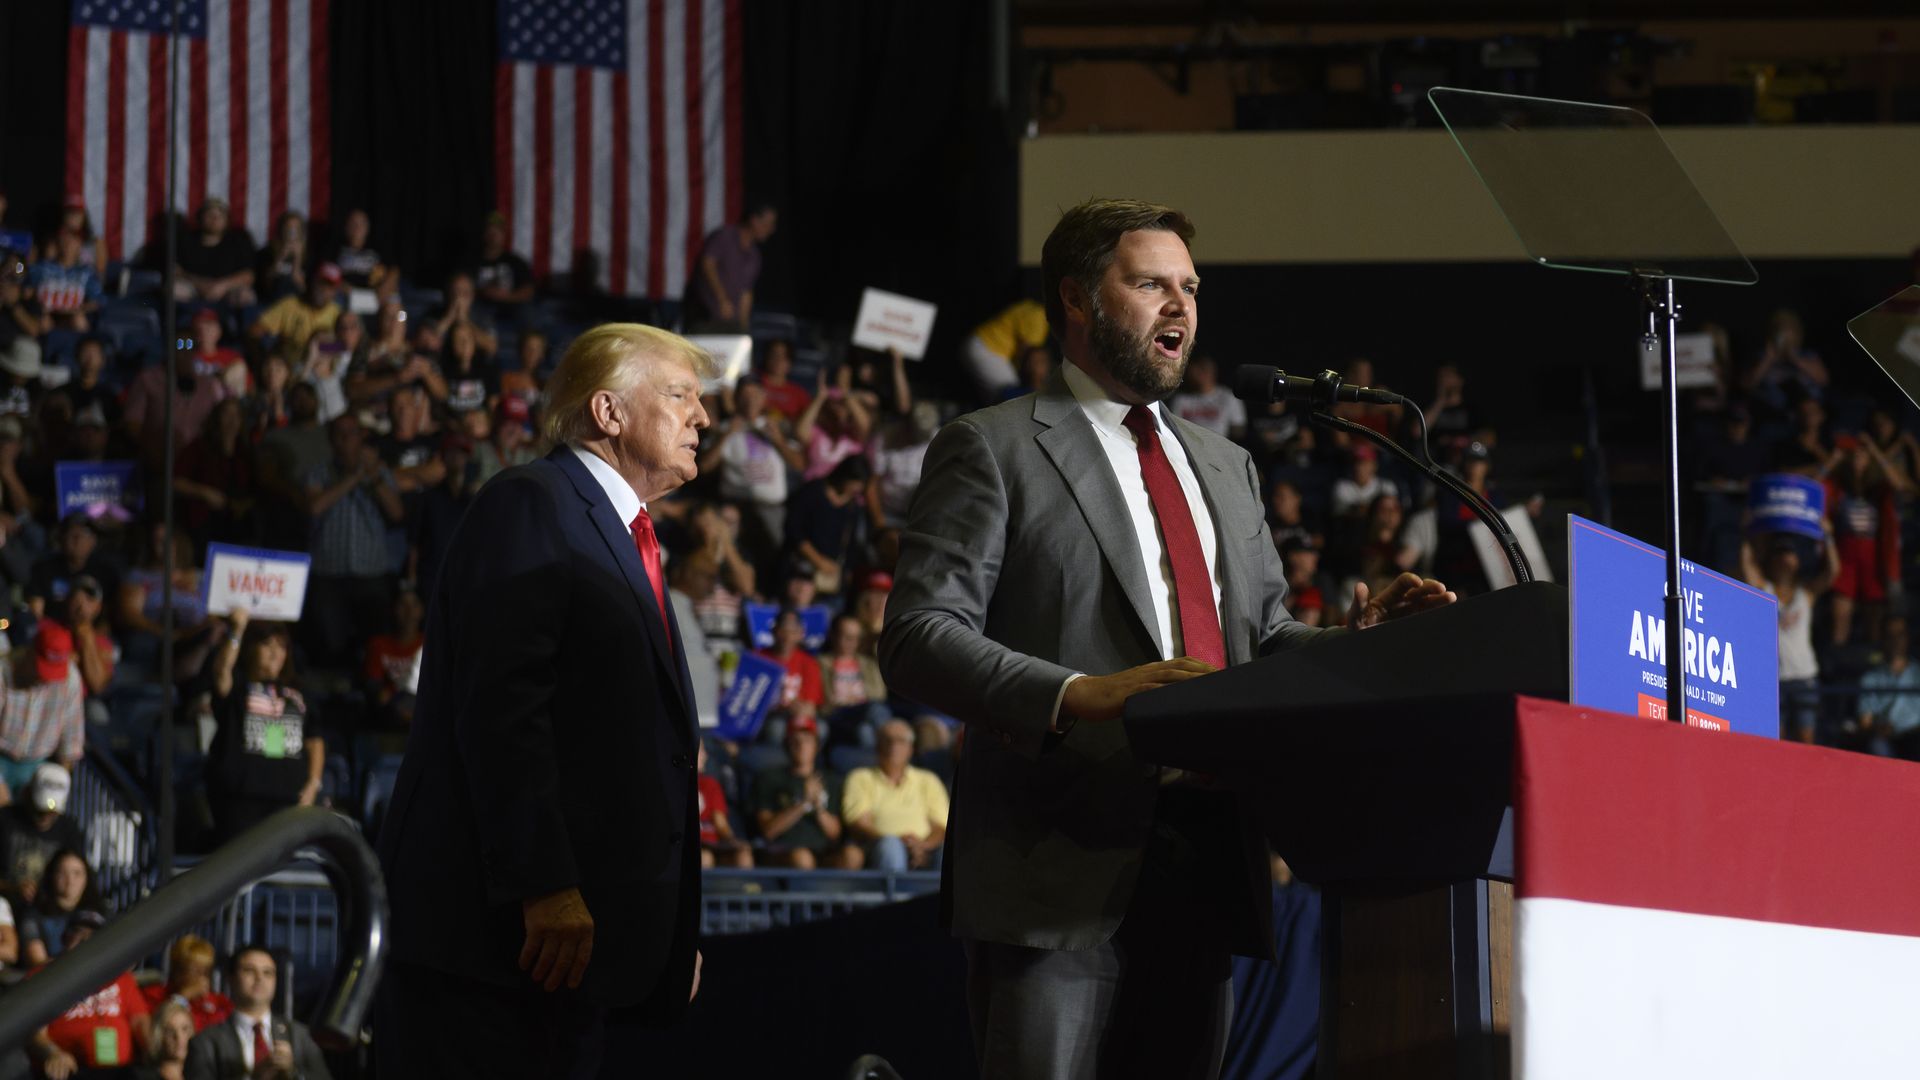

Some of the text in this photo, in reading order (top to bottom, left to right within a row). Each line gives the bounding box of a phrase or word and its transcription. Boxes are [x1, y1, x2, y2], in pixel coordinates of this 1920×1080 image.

[228, 568, 287, 598] VANCE
[1664, 581, 1704, 624] VE
[1628, 610, 1738, 689] AMRICA
[1642, 670, 1667, 690] PRESIDE
[1701, 689, 1706, 701] J.
[1706, 691, 1726, 707] TRUMP
[1648, 702, 1667, 721] TEXT
